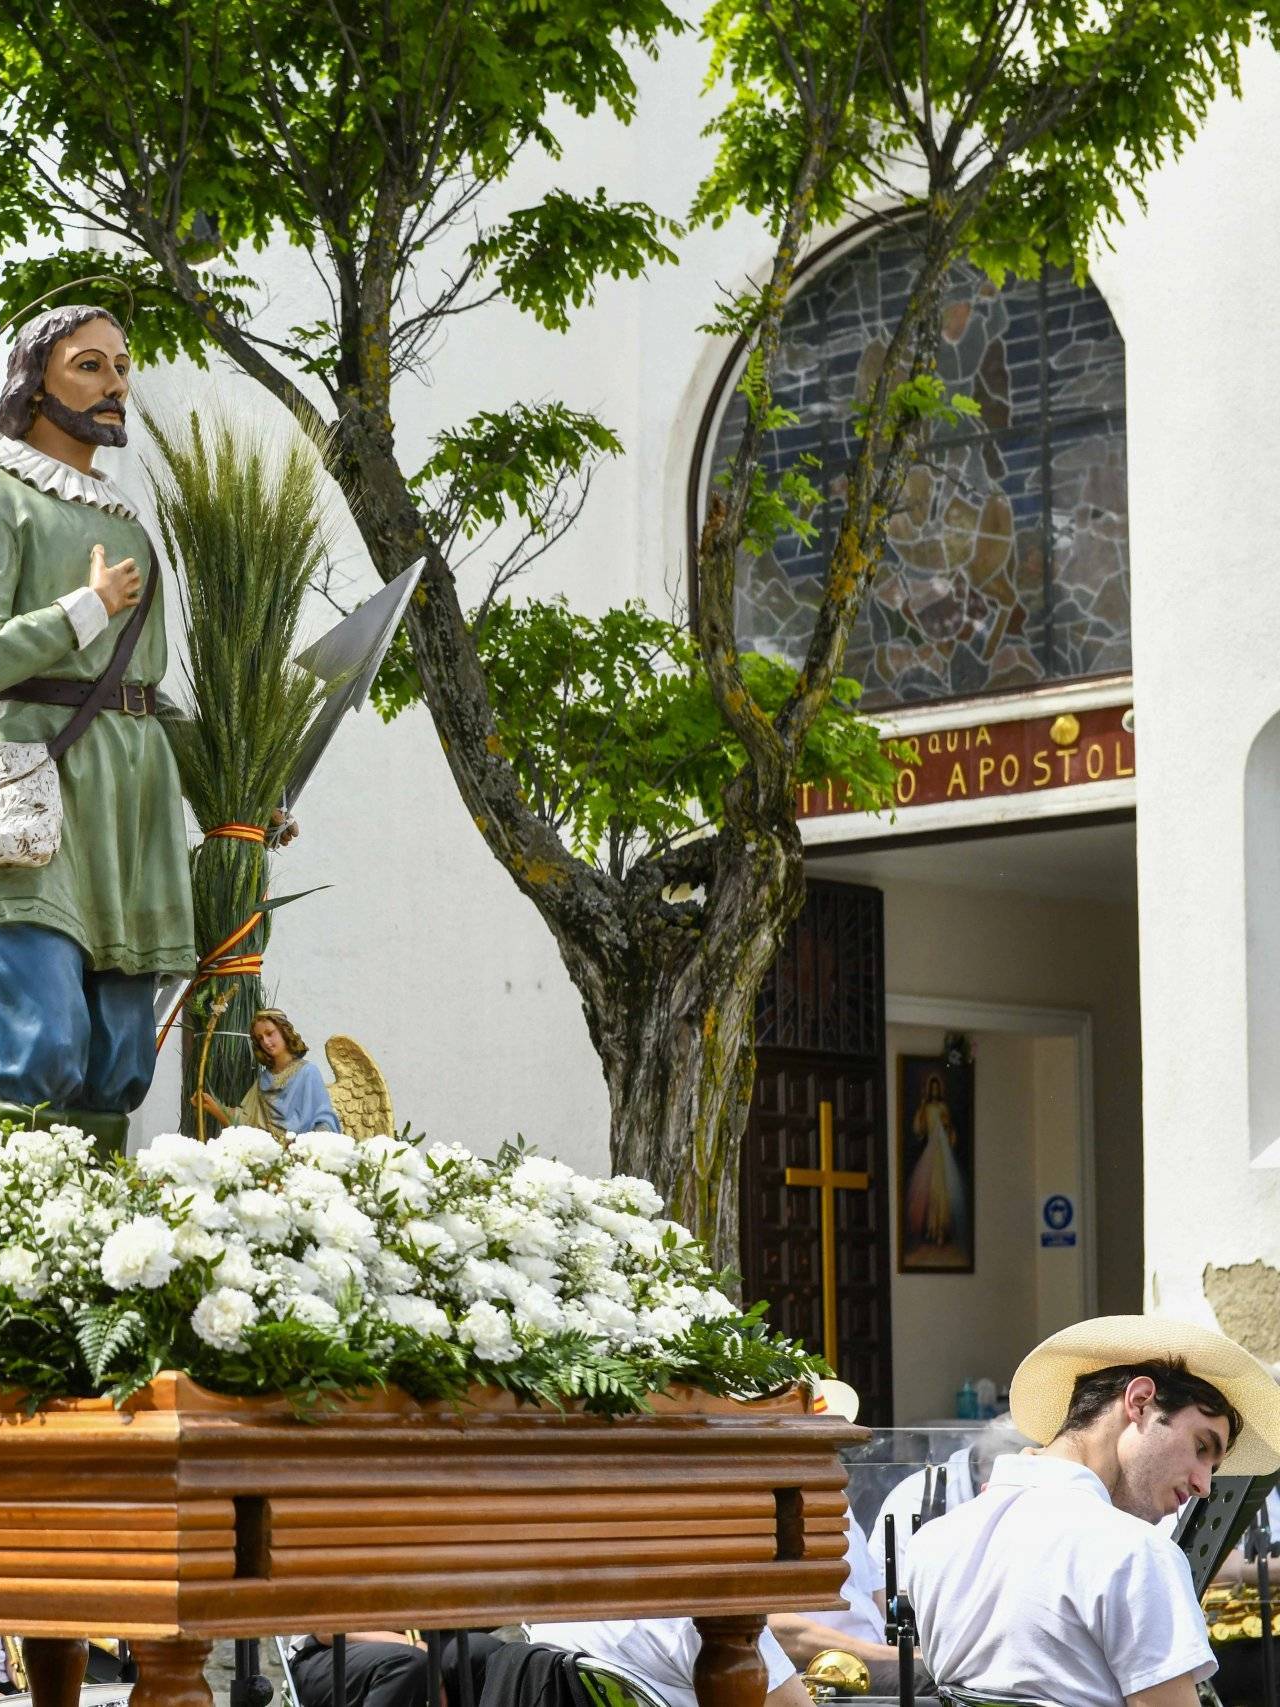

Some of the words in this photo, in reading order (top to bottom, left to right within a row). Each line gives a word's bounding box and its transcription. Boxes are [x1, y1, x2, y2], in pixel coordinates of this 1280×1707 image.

[884, 725, 992, 760] ROQUIA
[796, 768, 916, 814] TIO
[946, 741, 1134, 797] APOSTOL
